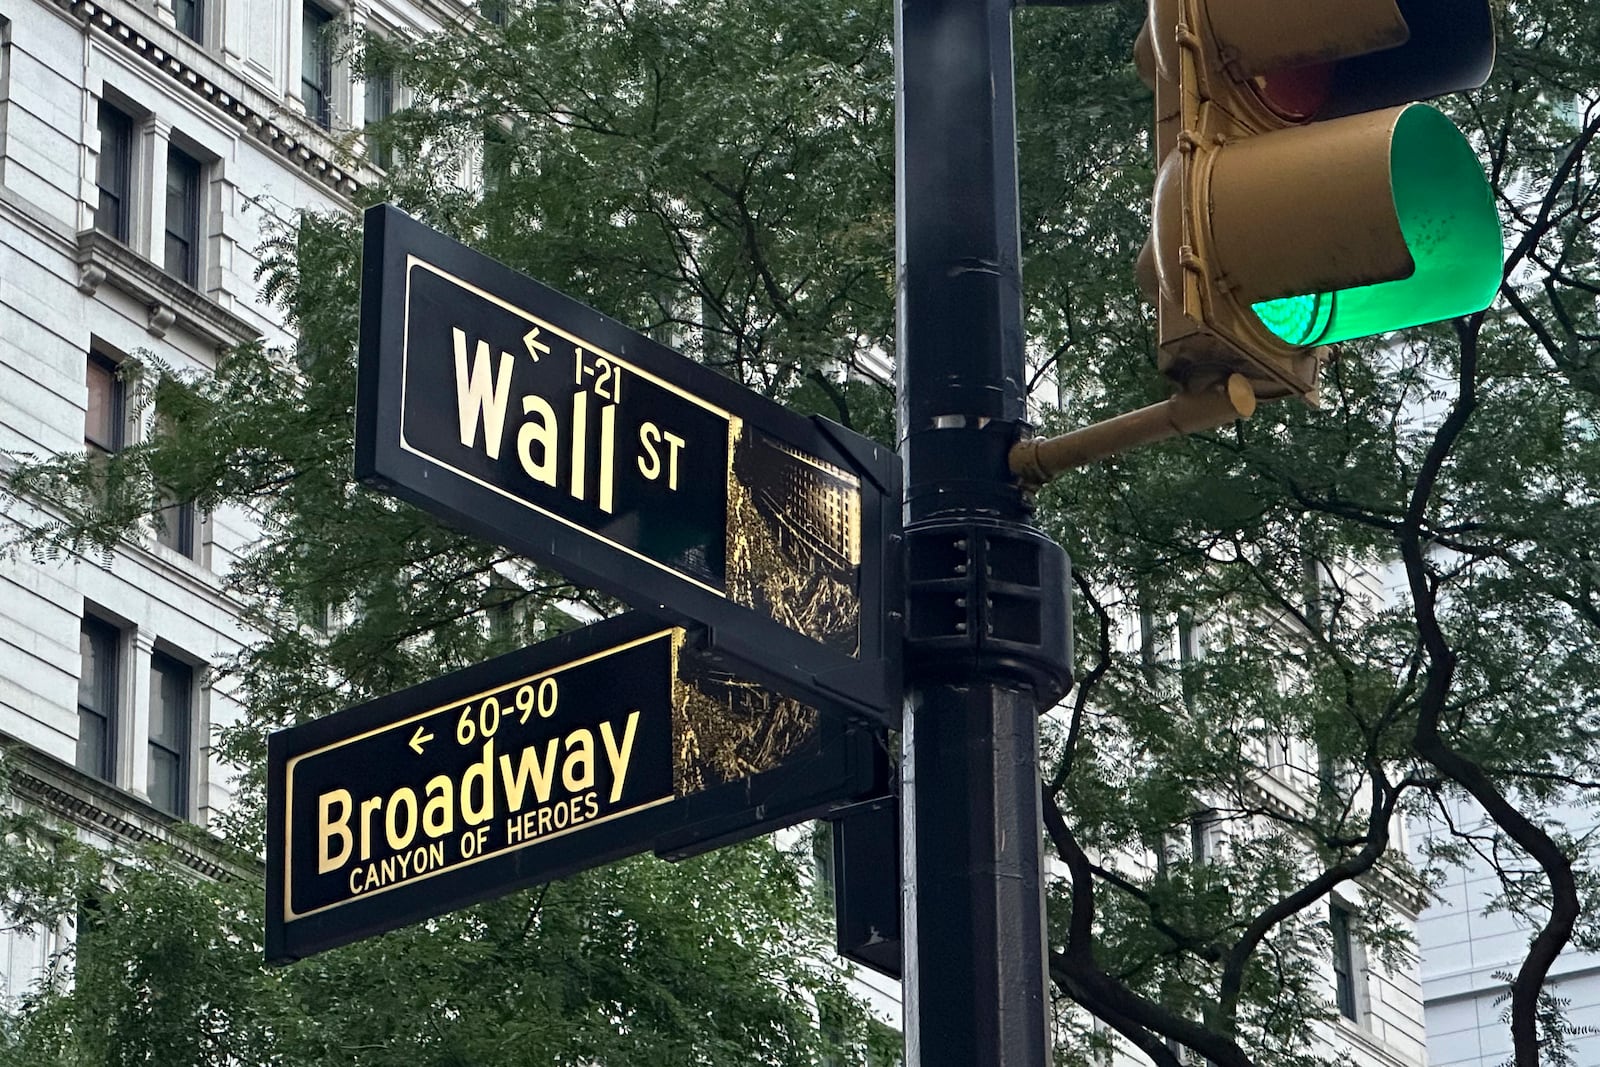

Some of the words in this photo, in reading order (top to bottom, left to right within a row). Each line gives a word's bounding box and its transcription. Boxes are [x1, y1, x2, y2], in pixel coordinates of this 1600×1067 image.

[452, 326, 616, 513] Wall
[637, 421, 686, 491] ST
[574, 347, 621, 404] 1-21
[456, 677, 558, 746] 60-90
[318, 710, 641, 875] Broadway
[349, 840, 444, 896] CANYON
[460, 825, 491, 859] OF
[507, 791, 599, 845] HEROES
